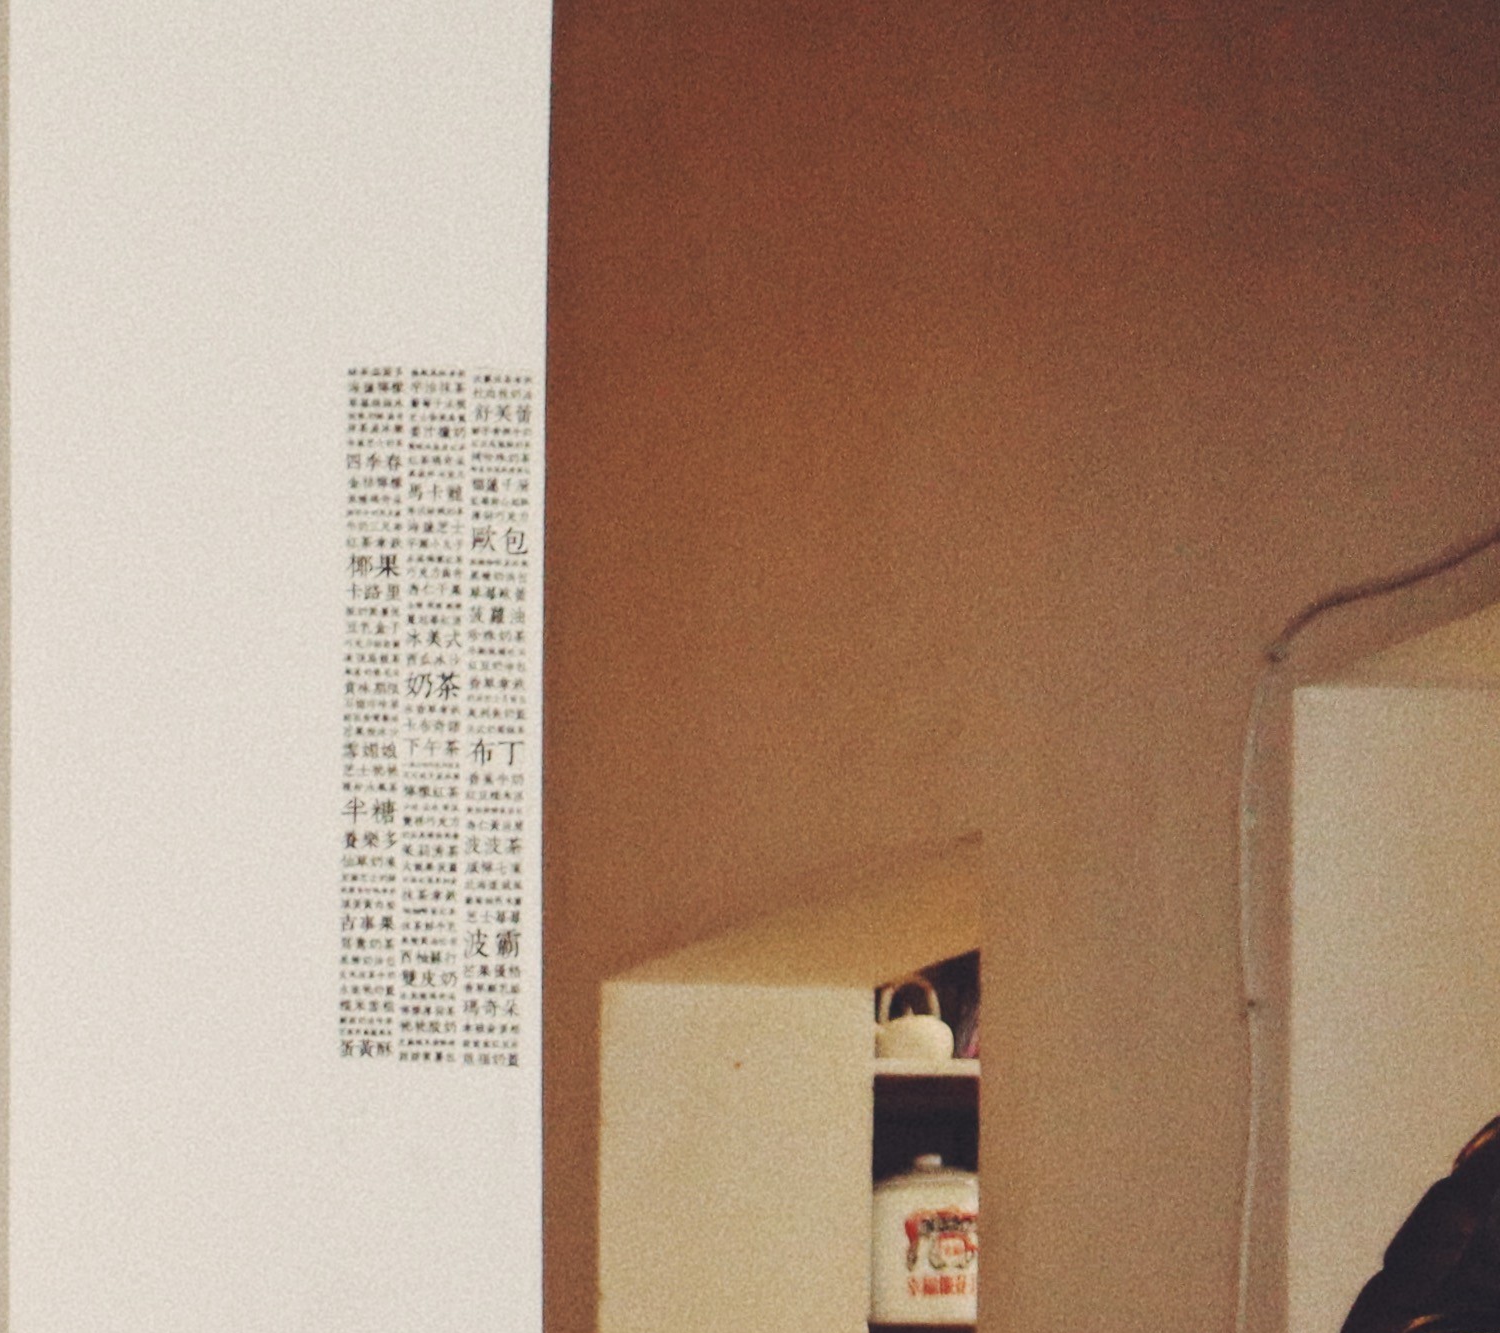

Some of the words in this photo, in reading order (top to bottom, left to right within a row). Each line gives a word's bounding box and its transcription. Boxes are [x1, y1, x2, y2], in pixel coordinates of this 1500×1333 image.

[346, 553, 400, 579] 椰果
[406, 674, 462, 700] 奶茶
[468, 738, 525, 765] 布丁
[342, 797, 396, 826] 半糖
